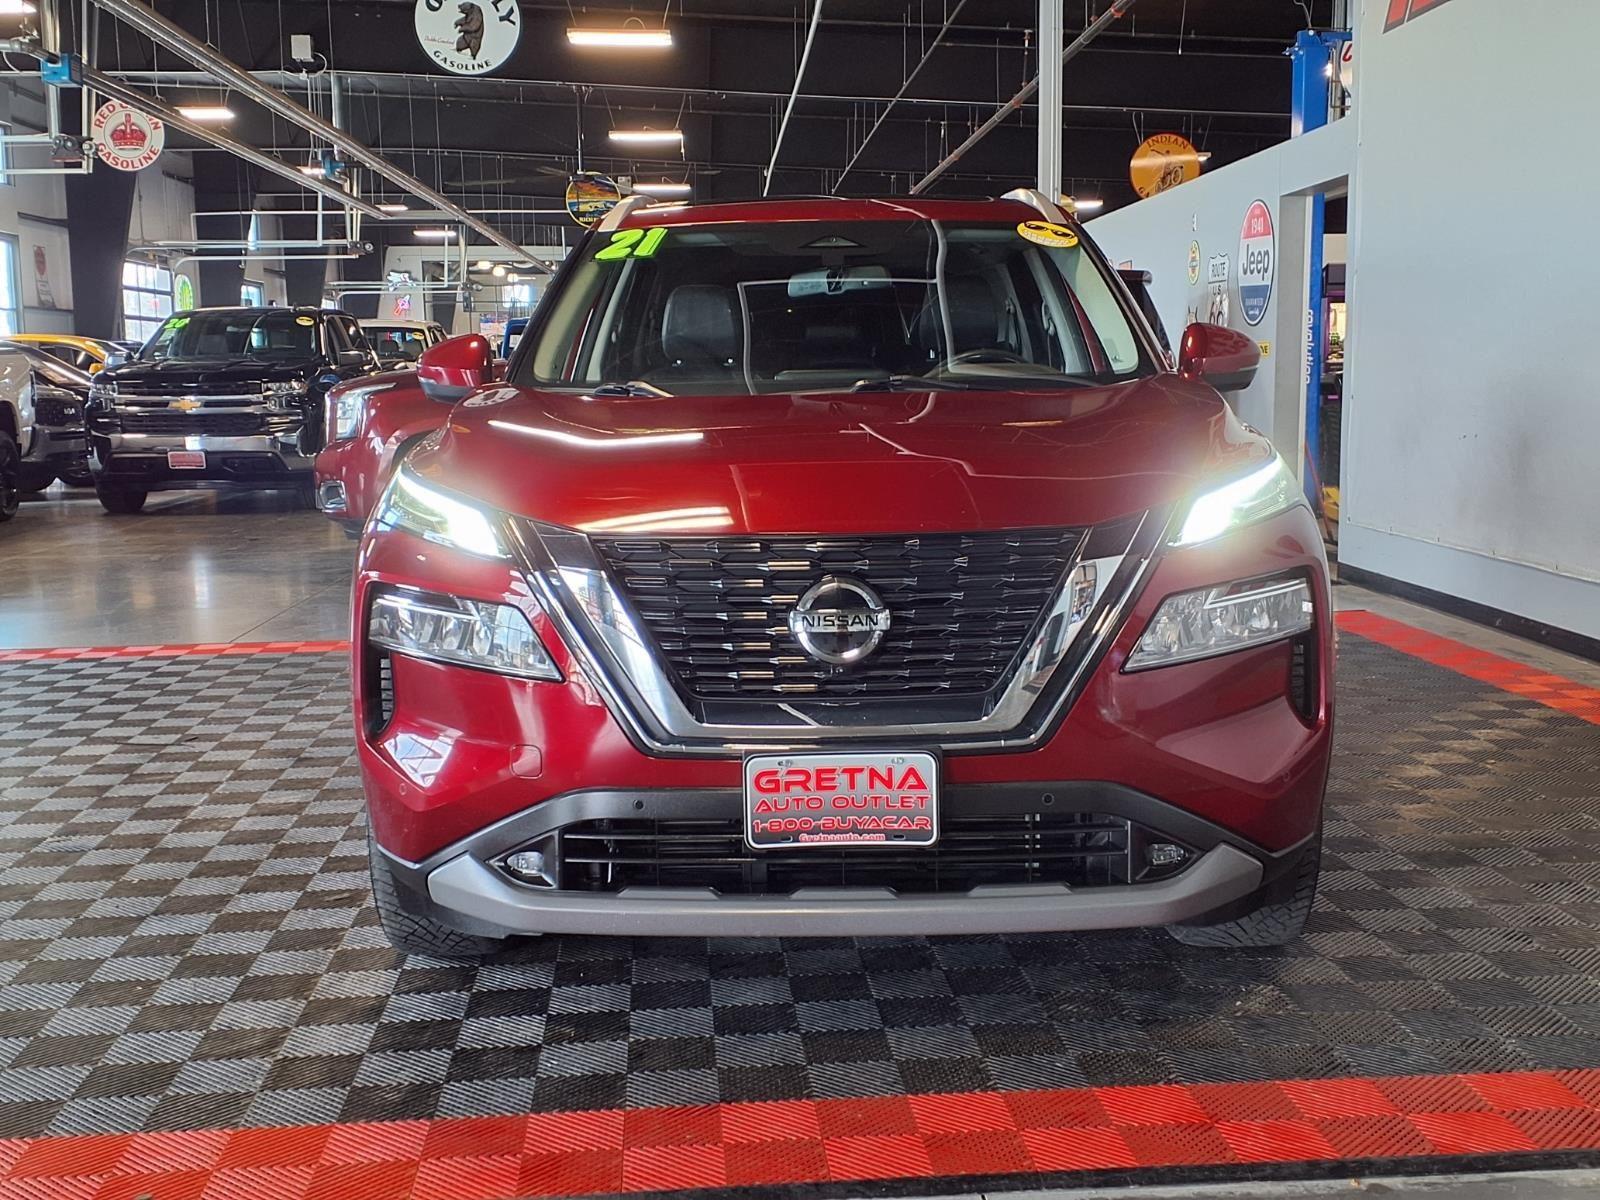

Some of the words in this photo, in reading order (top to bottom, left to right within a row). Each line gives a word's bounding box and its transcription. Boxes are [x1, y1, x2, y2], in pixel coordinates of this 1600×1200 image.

[433, 50, 492, 71] GASOLINE
[94, 103, 116, 129] RED
[1146, 135, 1188, 149] INDIAN
[98, 143, 160, 169] GASOLINE
[1251, 216, 1264, 234] 1941
[595, 227, 668, 260] 21
[1211, 262, 1226, 278] ROUTE
[1242, 243, 1270, 281] Jeep
[802, 615, 879, 627] NISSAN
[754, 765, 928, 794] GRETNA
[754, 797, 824, 813] AUTO
[831, 795, 930, 810] OUTLET
[753, 816, 931, 833] 1-800-BUYACAR
